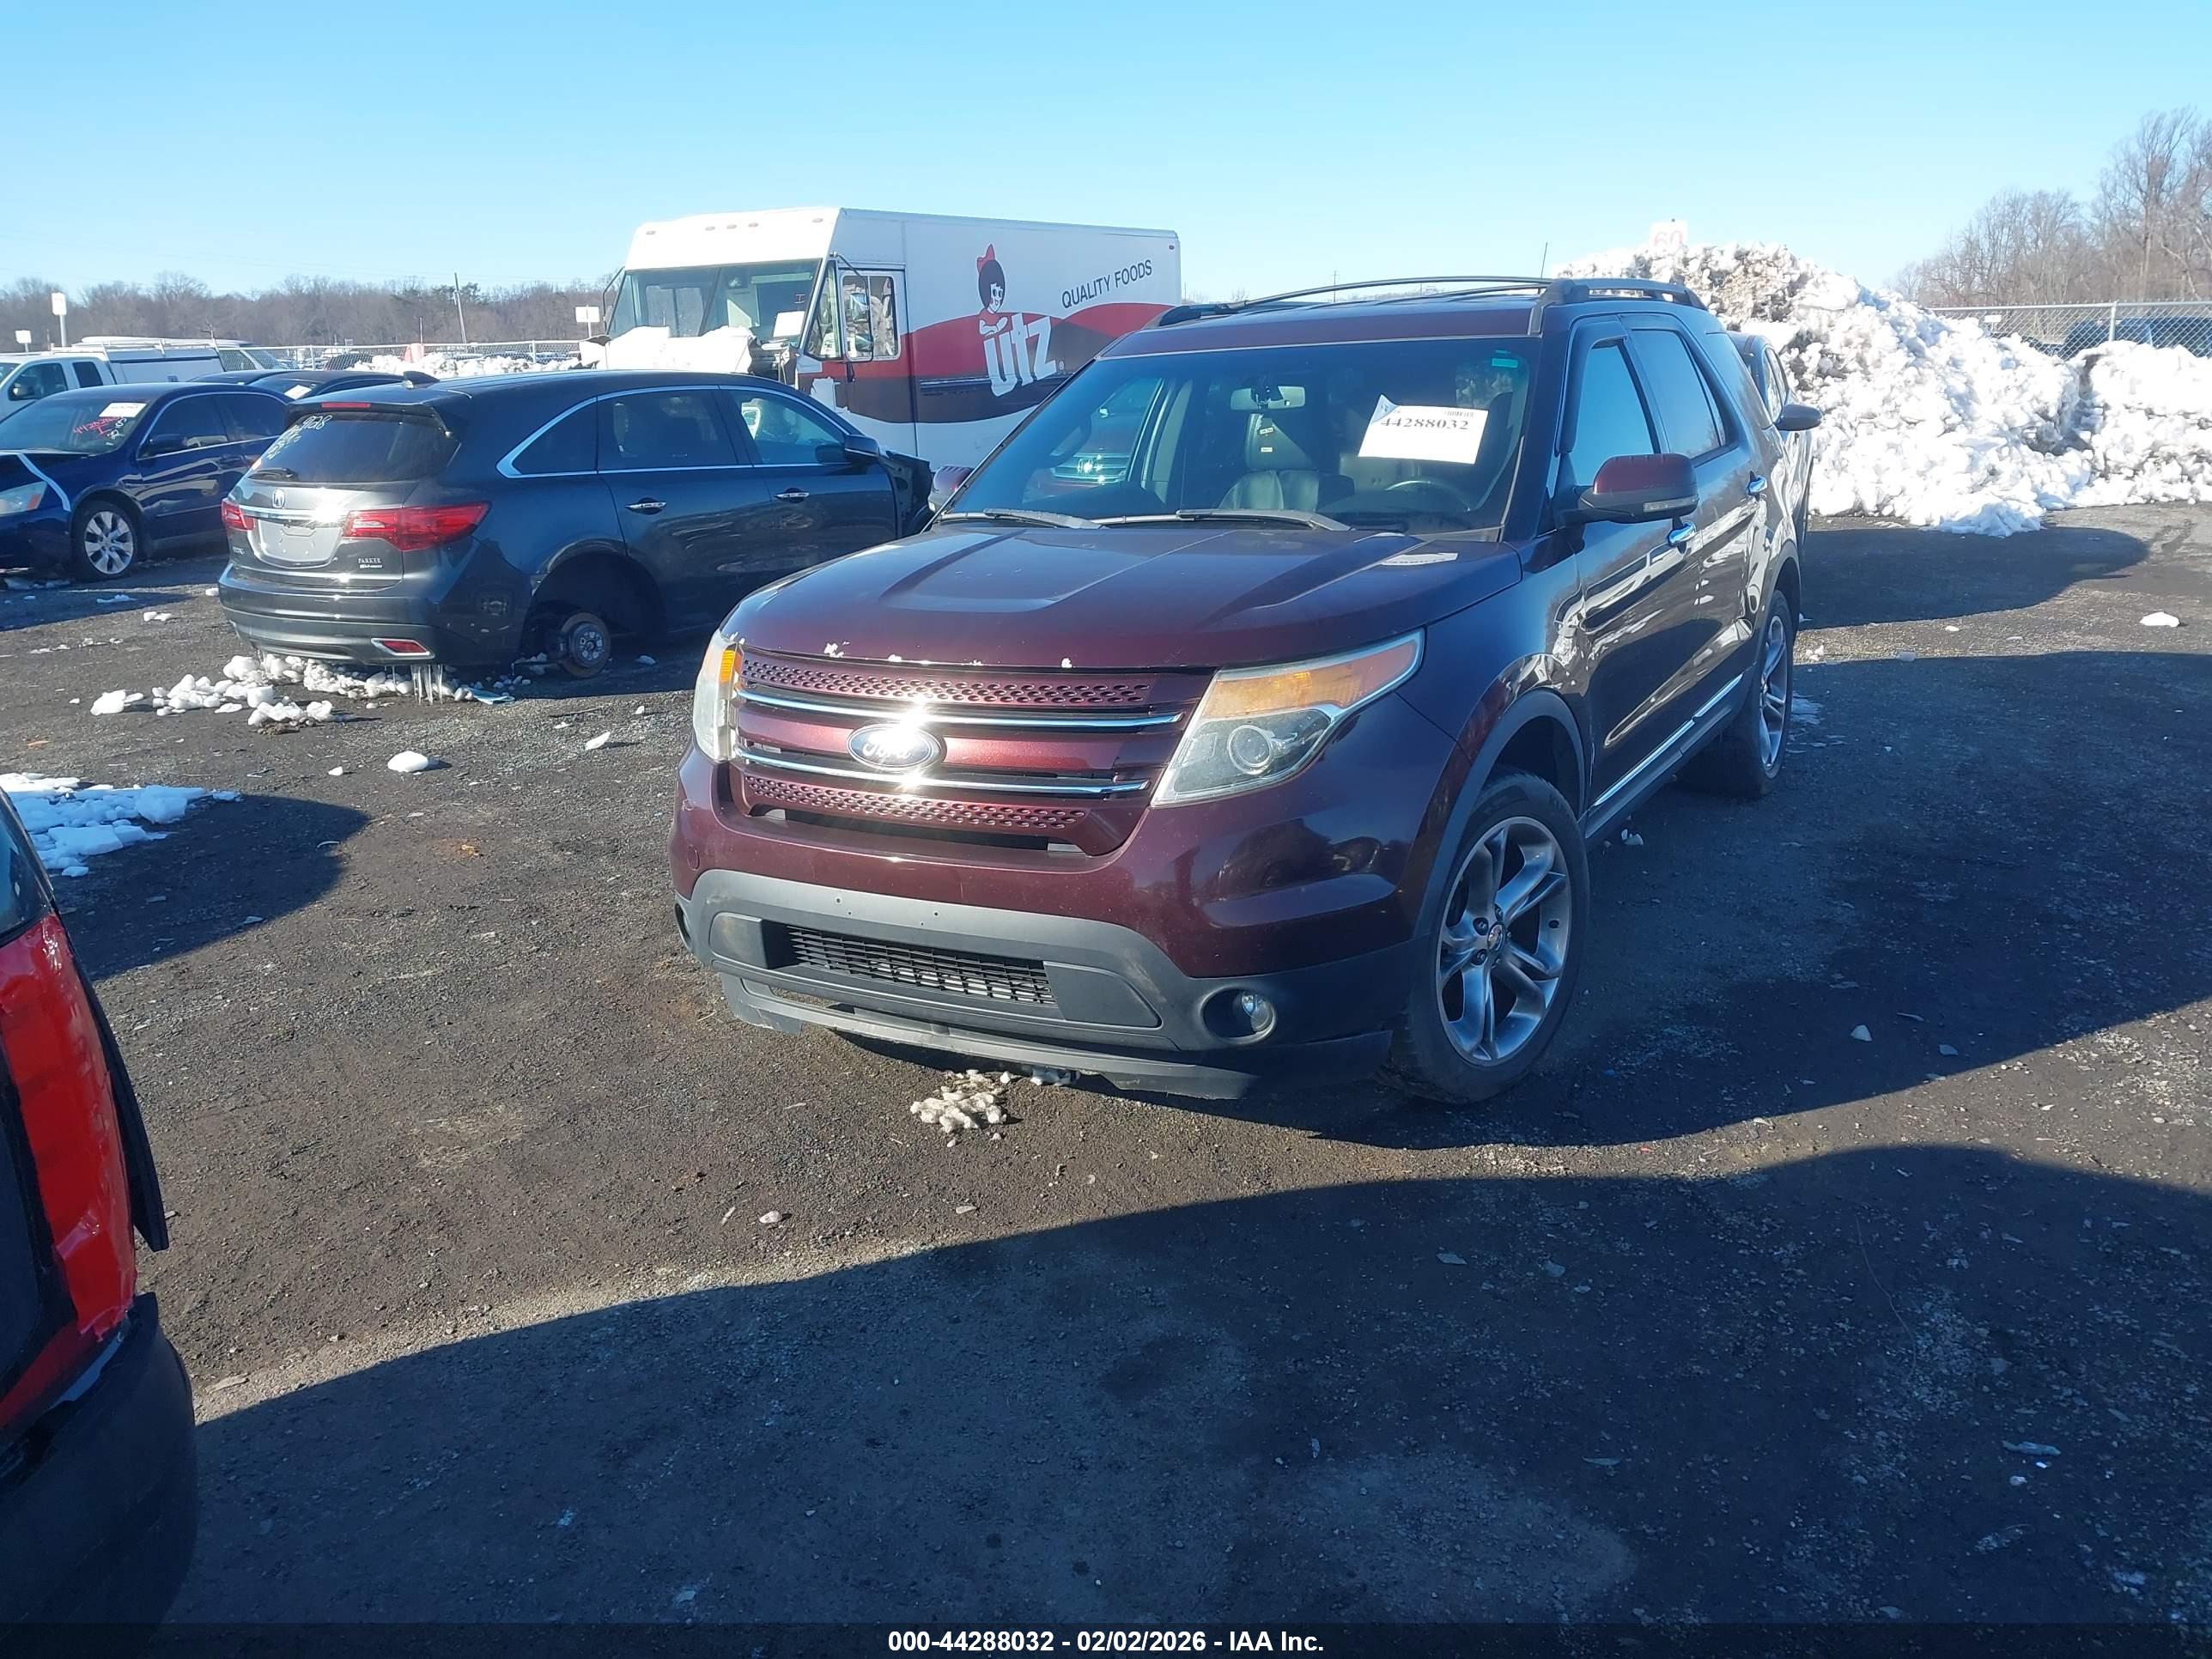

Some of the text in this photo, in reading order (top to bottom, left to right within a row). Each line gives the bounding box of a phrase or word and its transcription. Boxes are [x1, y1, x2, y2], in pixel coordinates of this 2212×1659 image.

[1061, 259, 1152, 309] QUALITY FOODS
[1381, 417, 1468, 430] 44288032
